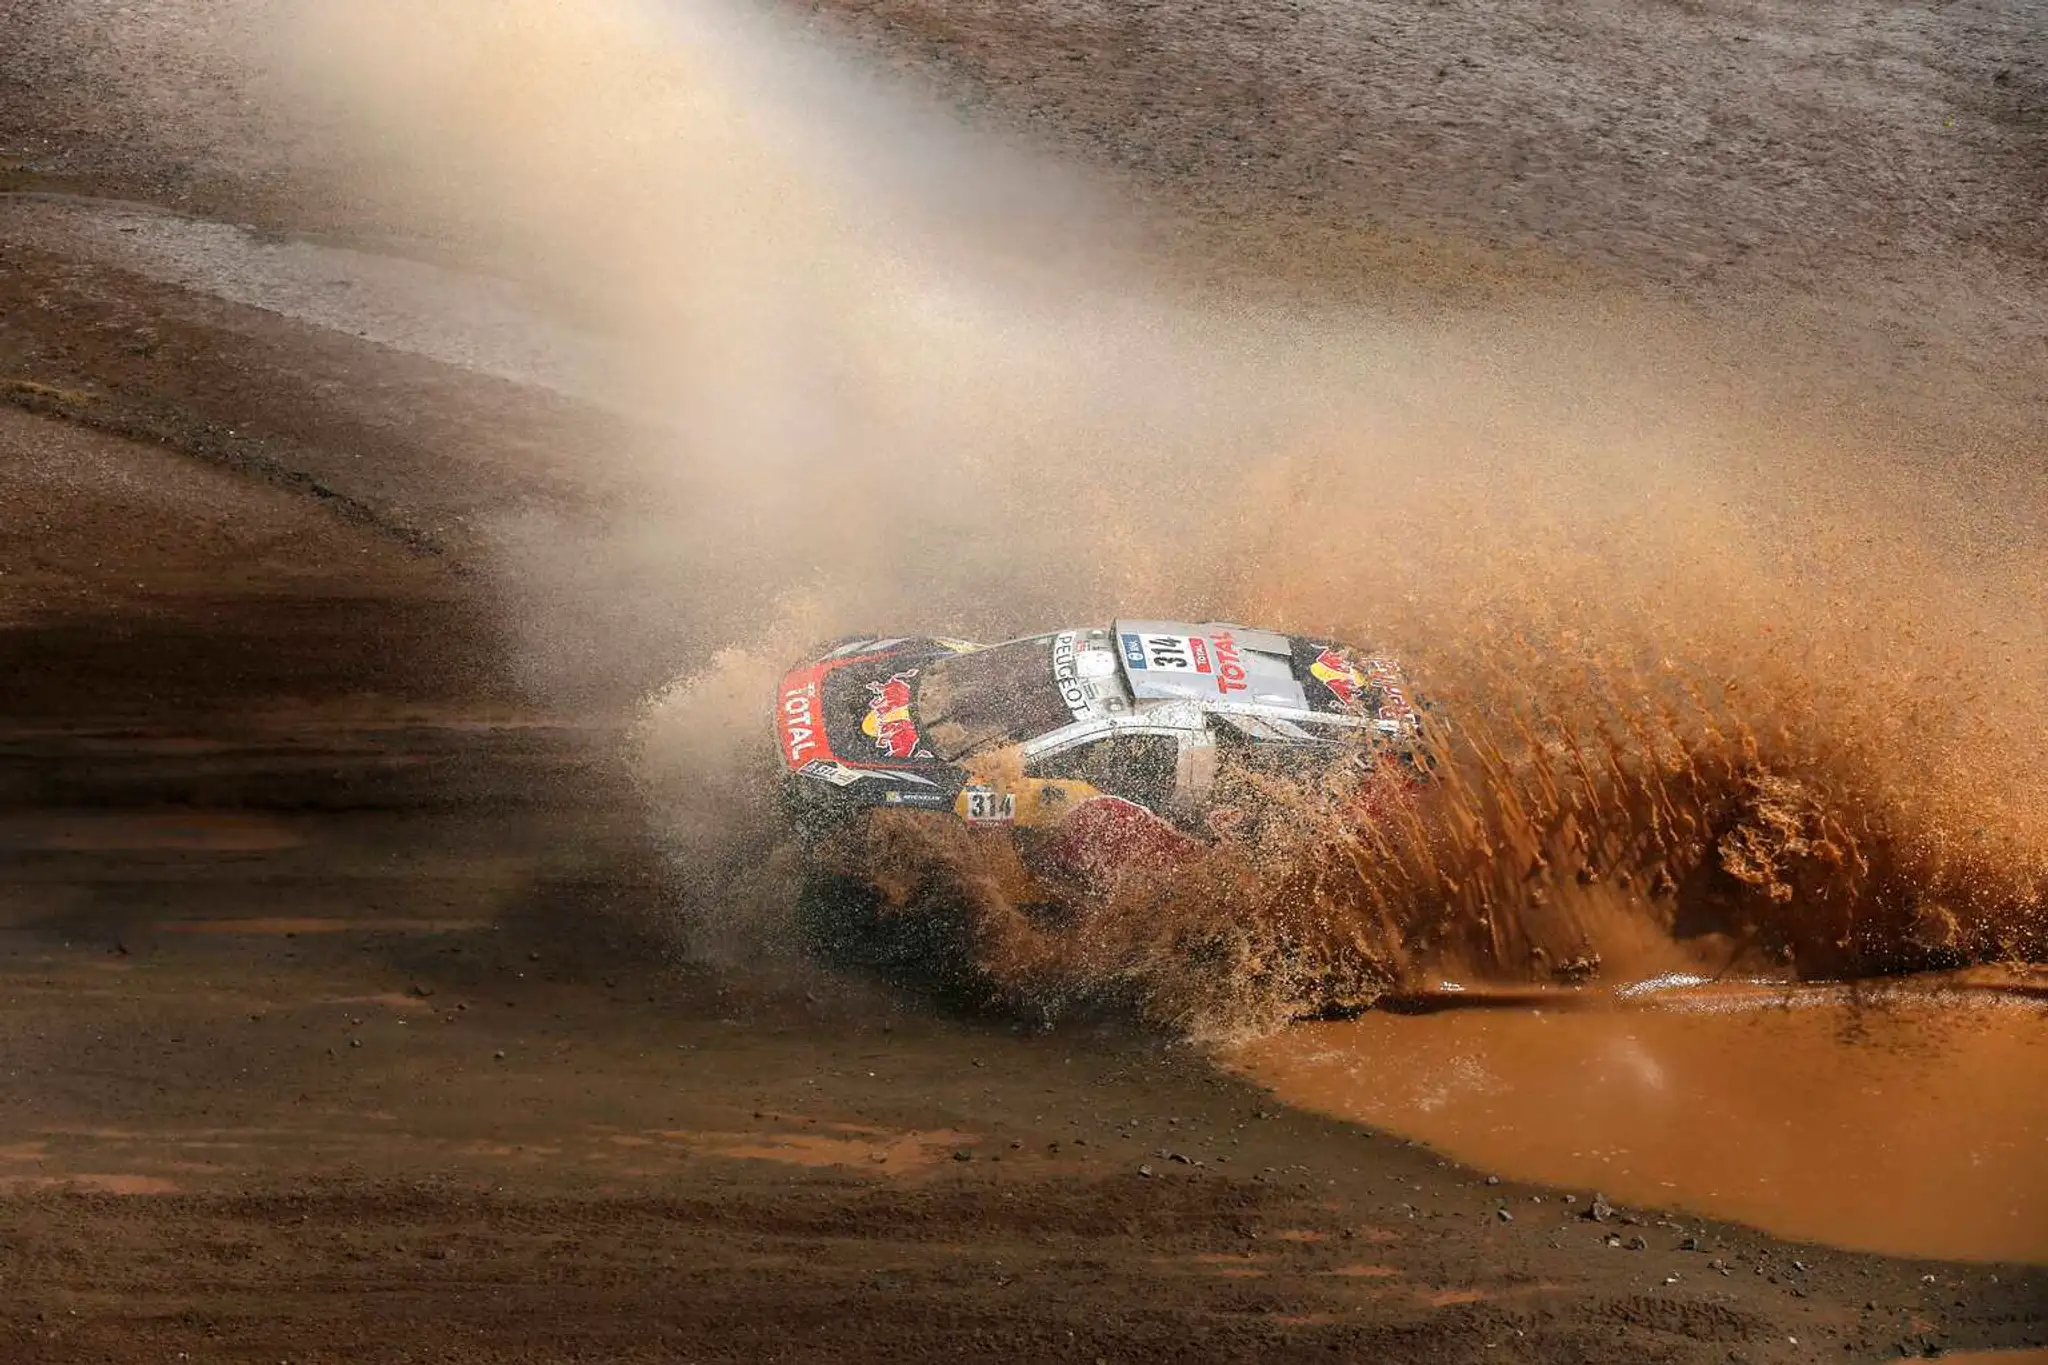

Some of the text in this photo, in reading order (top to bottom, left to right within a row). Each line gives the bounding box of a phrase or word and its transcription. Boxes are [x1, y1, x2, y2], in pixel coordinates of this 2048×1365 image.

[1056, 636, 1090, 711] PEUGEOT
[1148, 637, 1188, 667] 314
[1209, 631, 1247, 694] TOTAL
[785, 682, 815, 760] TOTAL
[972, 794, 1011, 817] 314
